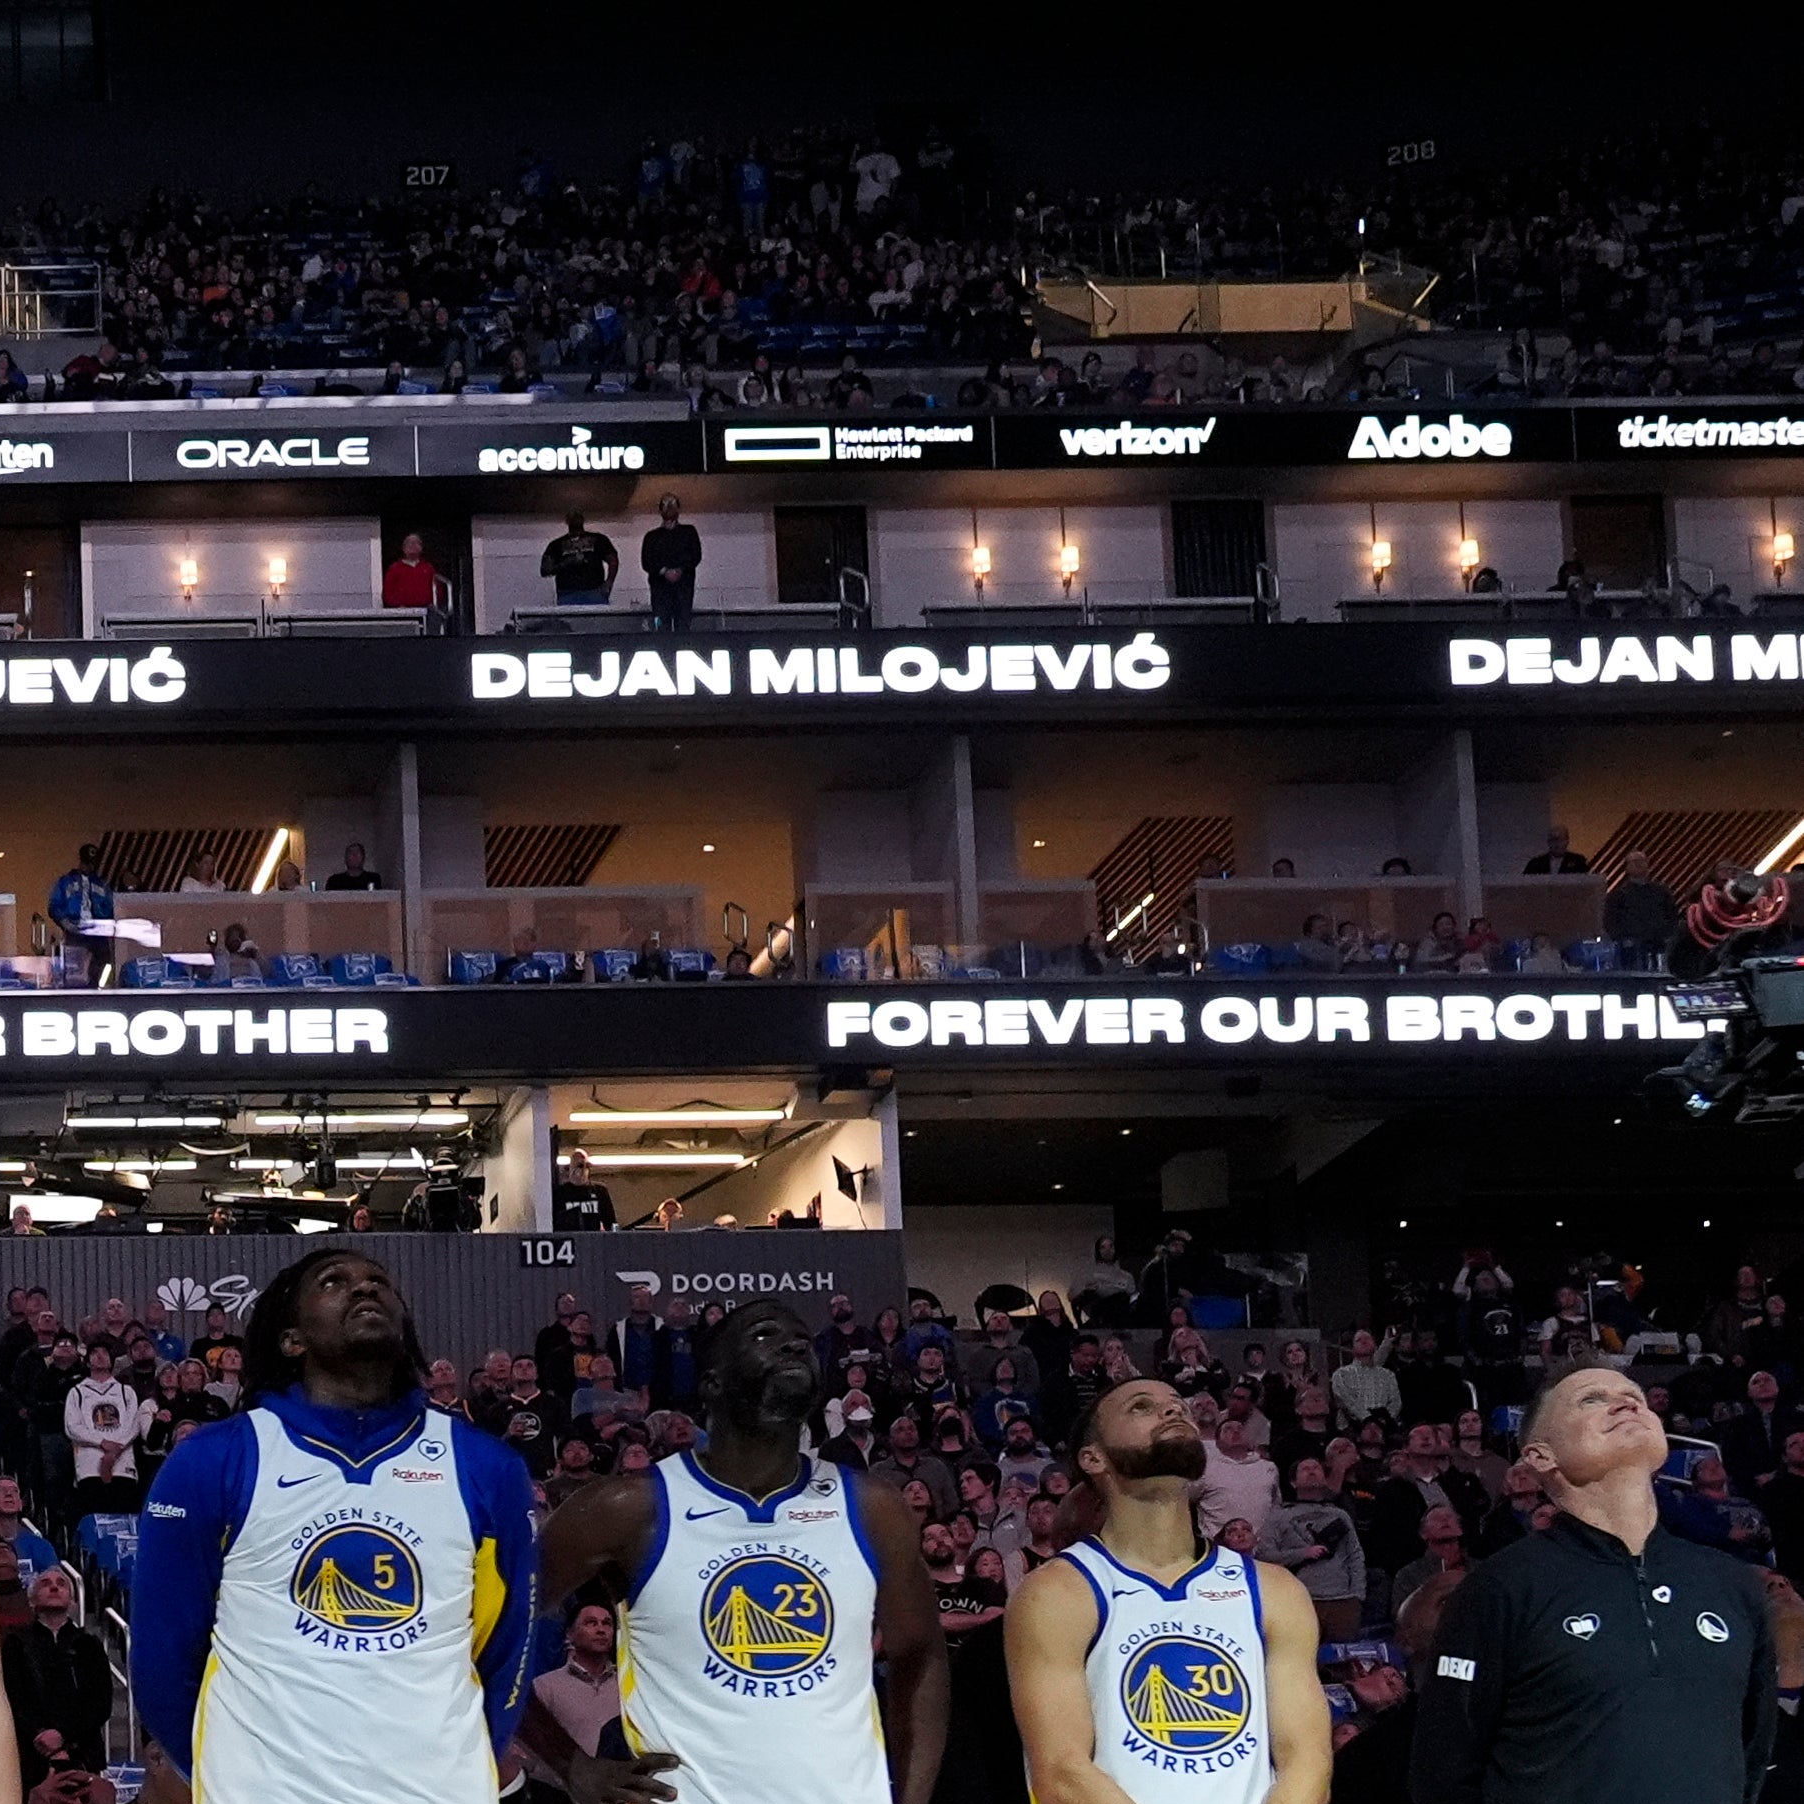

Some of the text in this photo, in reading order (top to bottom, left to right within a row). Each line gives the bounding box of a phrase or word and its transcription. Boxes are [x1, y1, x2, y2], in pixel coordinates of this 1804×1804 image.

[405, 165, 449, 186] 207
[834, 425, 974, 445] Hewlett Packard
[1060, 420, 1203, 456] verizon
[1347, 415, 1513, 459] Adobe
[1618, 415, 1804, 448] ticketmaste
[176, 437, 370, 469] ORACLE
[478, 440, 645, 472] accenture
[834, 443, 922, 462] Enterprise
[471, 632, 1171, 699] DEJAN MILOJEVIĆ
[1450, 636, 1715, 686] DEJAN
[22, 1008, 389, 1056] BROTHER
[827, 994, 1728, 1048] FOREVER OUR BROTH
[521, 1240, 575, 1265] 104
[672, 1272, 834, 1293] DOORDASH
[392, 1468, 444, 1482] Rakuten
[291, 1508, 424, 1551] GOLDEN STATE
[788, 1509, 839, 1523] Rakuten
[374, 1554, 395, 1589] 5
[698, 1542, 831, 1582] GOLDEN STATE
[772, 1584, 818, 1618] 23
[294, 1612, 429, 1652] WARRIORS
[1118, 1621, 1245, 1658] GOLDEN STATE
[701, 1656, 837, 1698] WARRIORS
[1186, 1664, 1233, 1697] 30
[1120, 1729, 1258, 1775] WARRIORS
